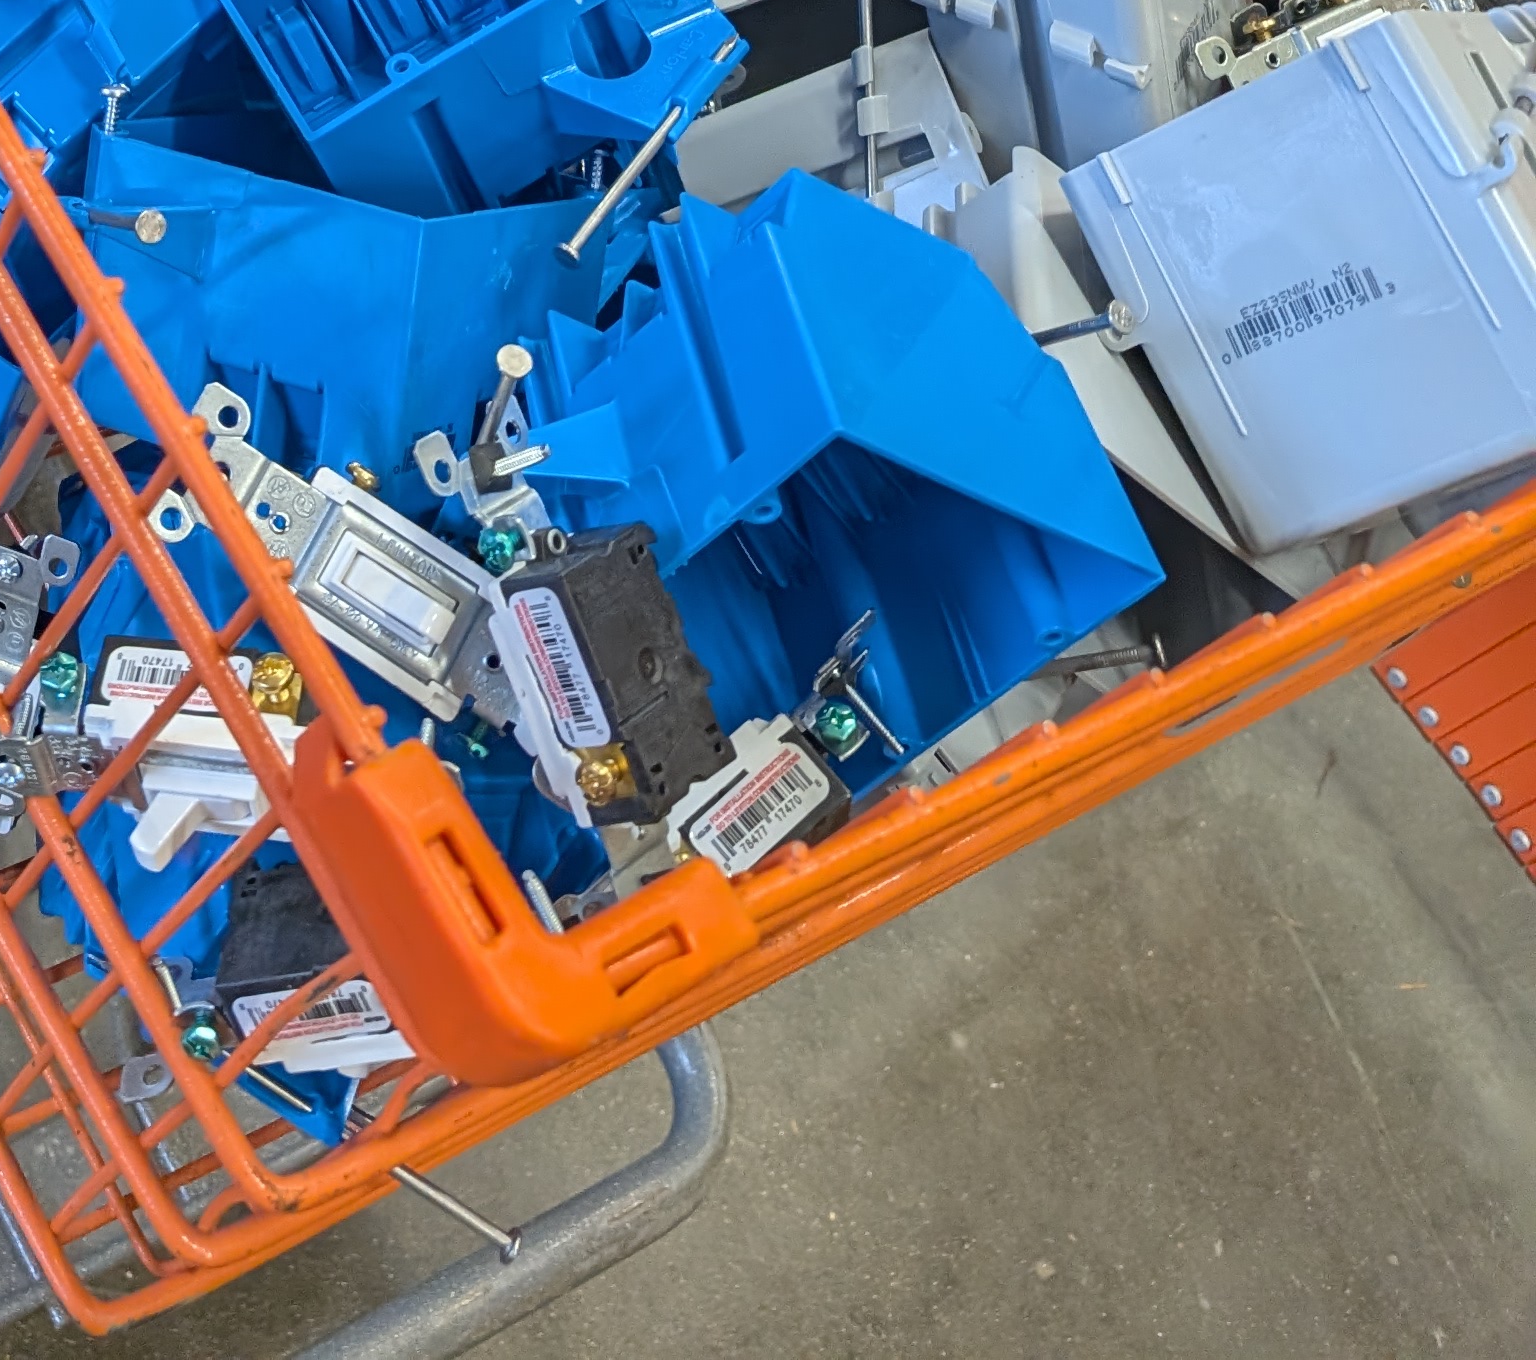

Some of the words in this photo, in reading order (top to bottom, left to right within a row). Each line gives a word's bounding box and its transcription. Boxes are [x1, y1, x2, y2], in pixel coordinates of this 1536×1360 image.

[1220, 352, 1233, 365] 0
[1384, 280, 1397, 295] 3
[554, 622, 572, 657] 17470
[141, 655, 173, 665] 17470
[719, 779, 756, 814] INSTALLATION
[739, 825, 768, 853] 78477
[774, 793, 802, 822] 17470
